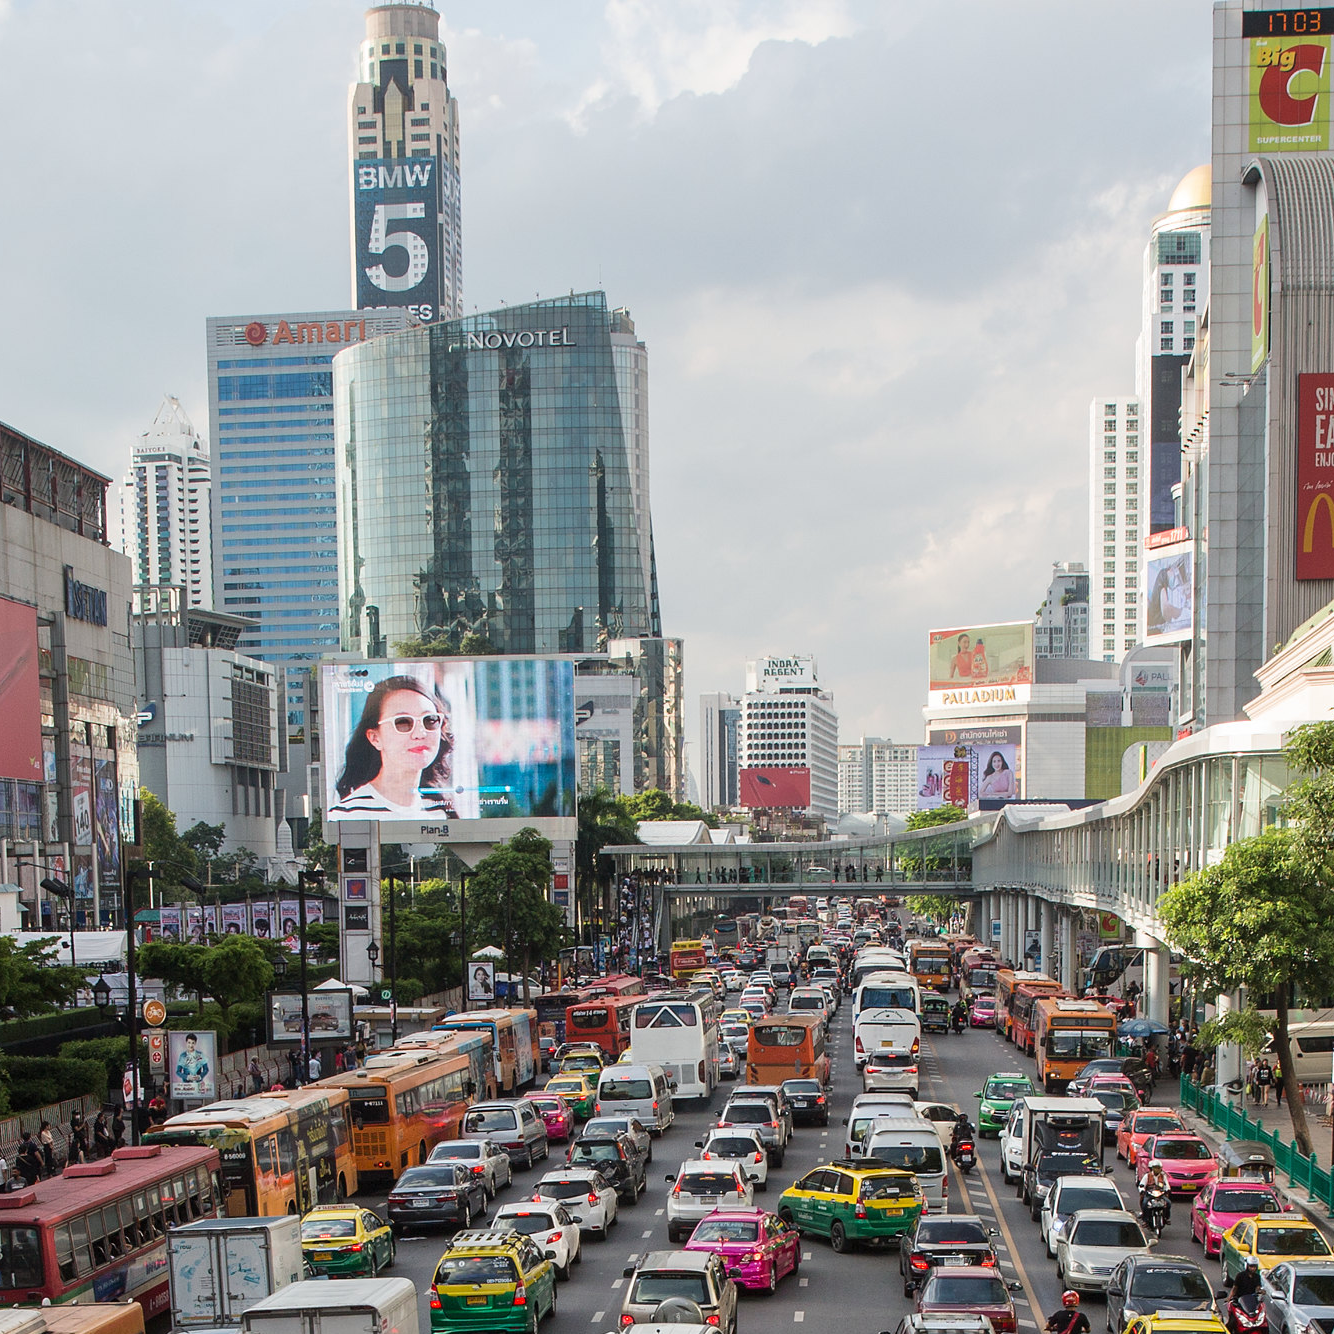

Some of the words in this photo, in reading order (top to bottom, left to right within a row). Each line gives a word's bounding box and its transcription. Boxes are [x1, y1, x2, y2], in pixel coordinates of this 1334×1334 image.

[1256, 45, 1297, 72] Big
[1259, 44, 1327, 127] C
[1257, 135, 1322, 144] SUPERCENTER
[358, 165, 431, 190] BMW
[365, 202, 429, 291] 5
[272, 319, 366, 346] Amari
[467, 327, 576, 350] NOVOTEL
[65, 565, 108, 627] ISETAN
[763, 668, 805, 676] REGENT
[768, 660, 800, 668] INDRA
[942, 686, 1016, 705] PALLADIUM
